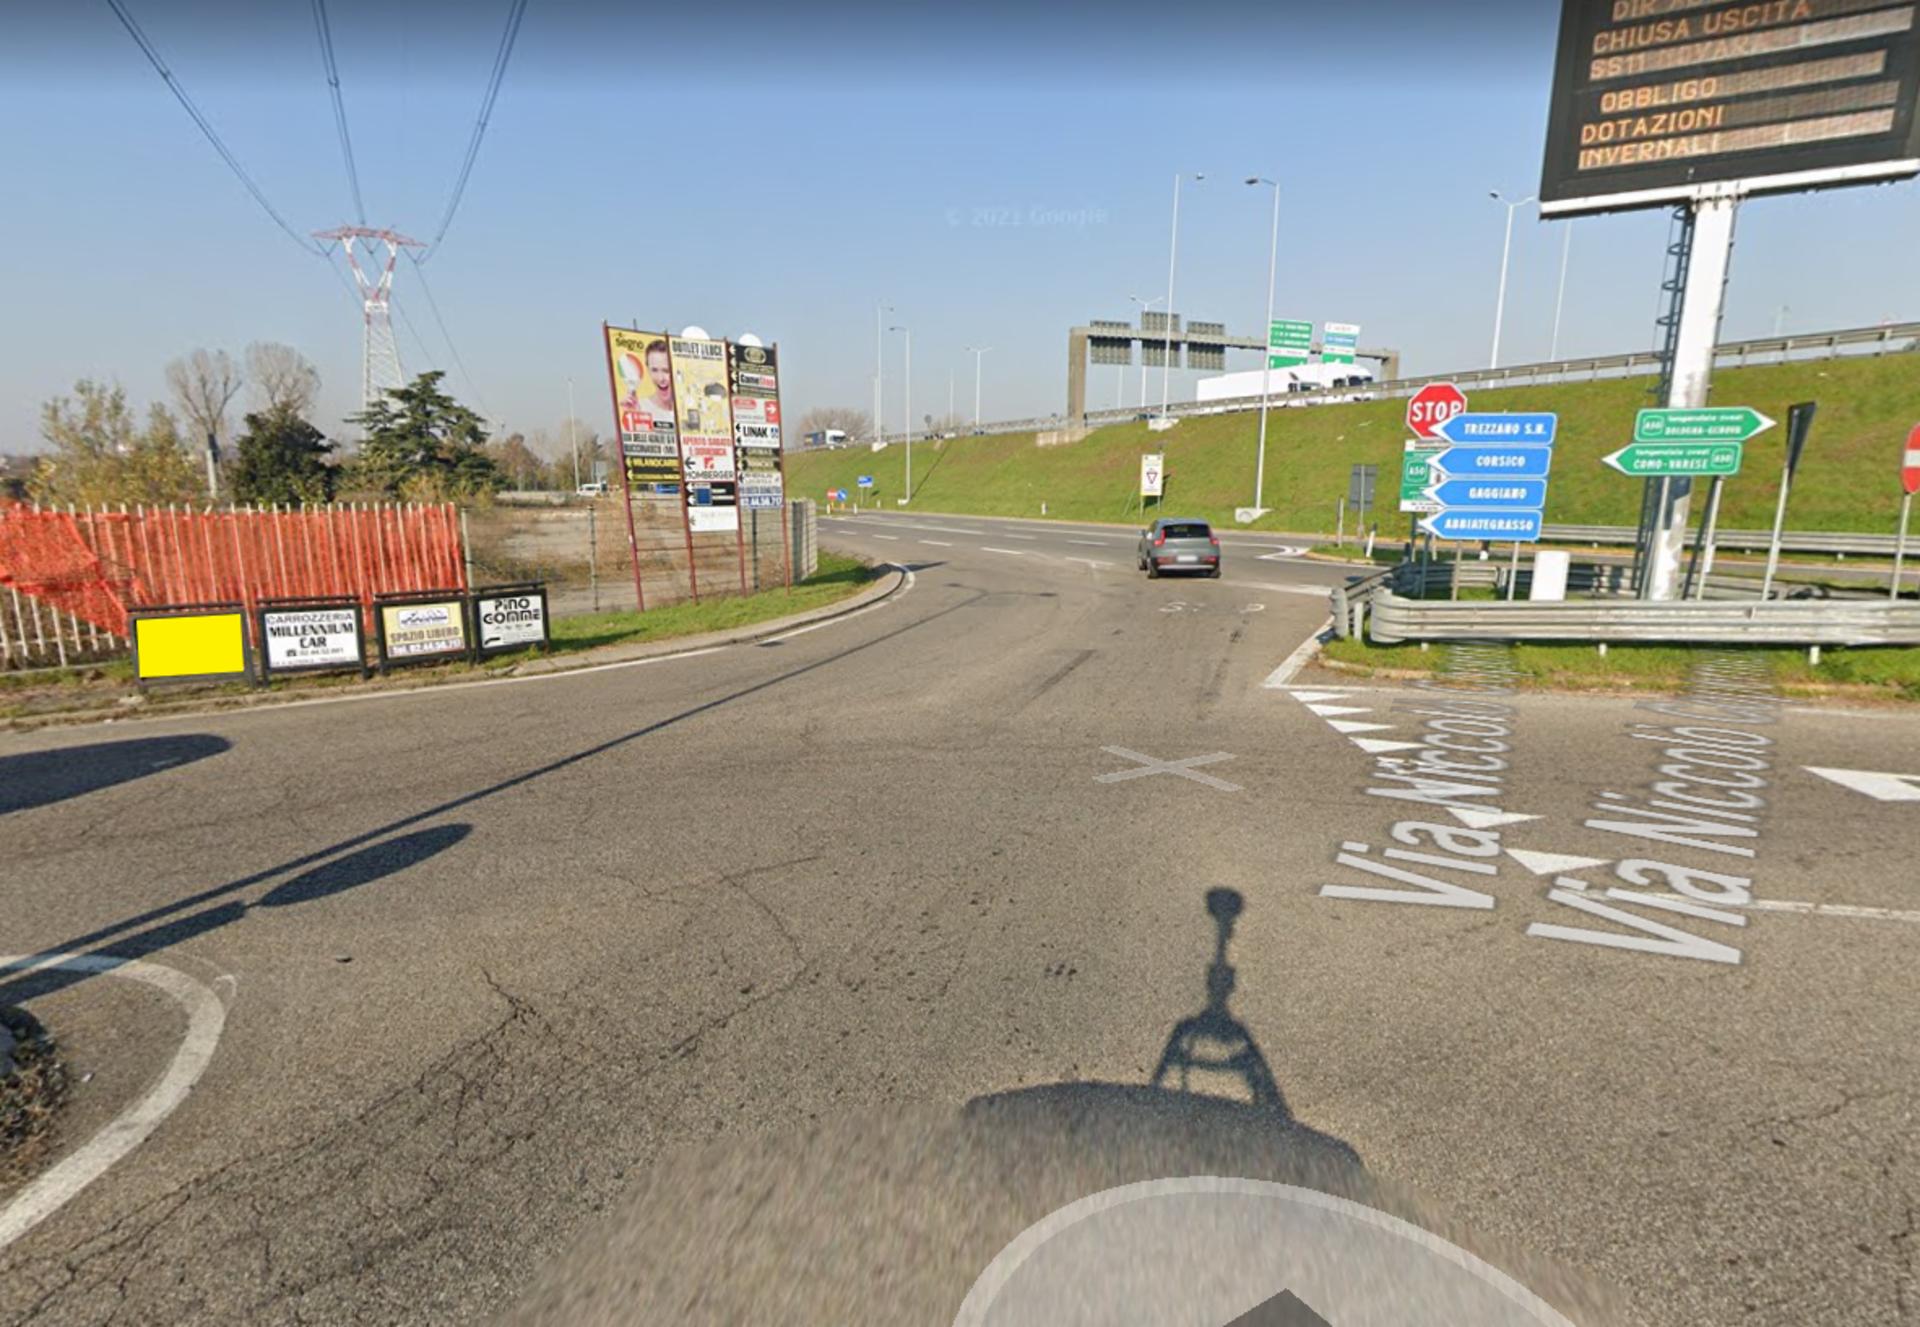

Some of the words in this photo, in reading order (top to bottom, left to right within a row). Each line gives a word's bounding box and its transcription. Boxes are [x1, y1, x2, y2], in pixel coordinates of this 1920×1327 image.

[1593, 18, 1690, 53] CHIUSA
[1704, 0, 1812, 34] USCITA
[1602, 77, 1717, 112] OBBLIGO
[1580, 104, 1724, 145] DOTAZIONI
[1579, 132, 1720, 170] INVERNALI
[1412, 401, 1462, 422] STOP
[743, 425, 768, 438] LINAK
[1464, 423, 1520, 435] TREZZANO
[1476, 455, 1526, 468] CORSICO
[1469, 486, 1527, 499] GAGGIANO
[1444, 518, 1534, 531] ABBIATEGRASSO
[267, 612, 352, 625] CARROZZERIA
[269, 622, 354, 638] MILLENNIUM
[300, 636, 328, 649] CAR
